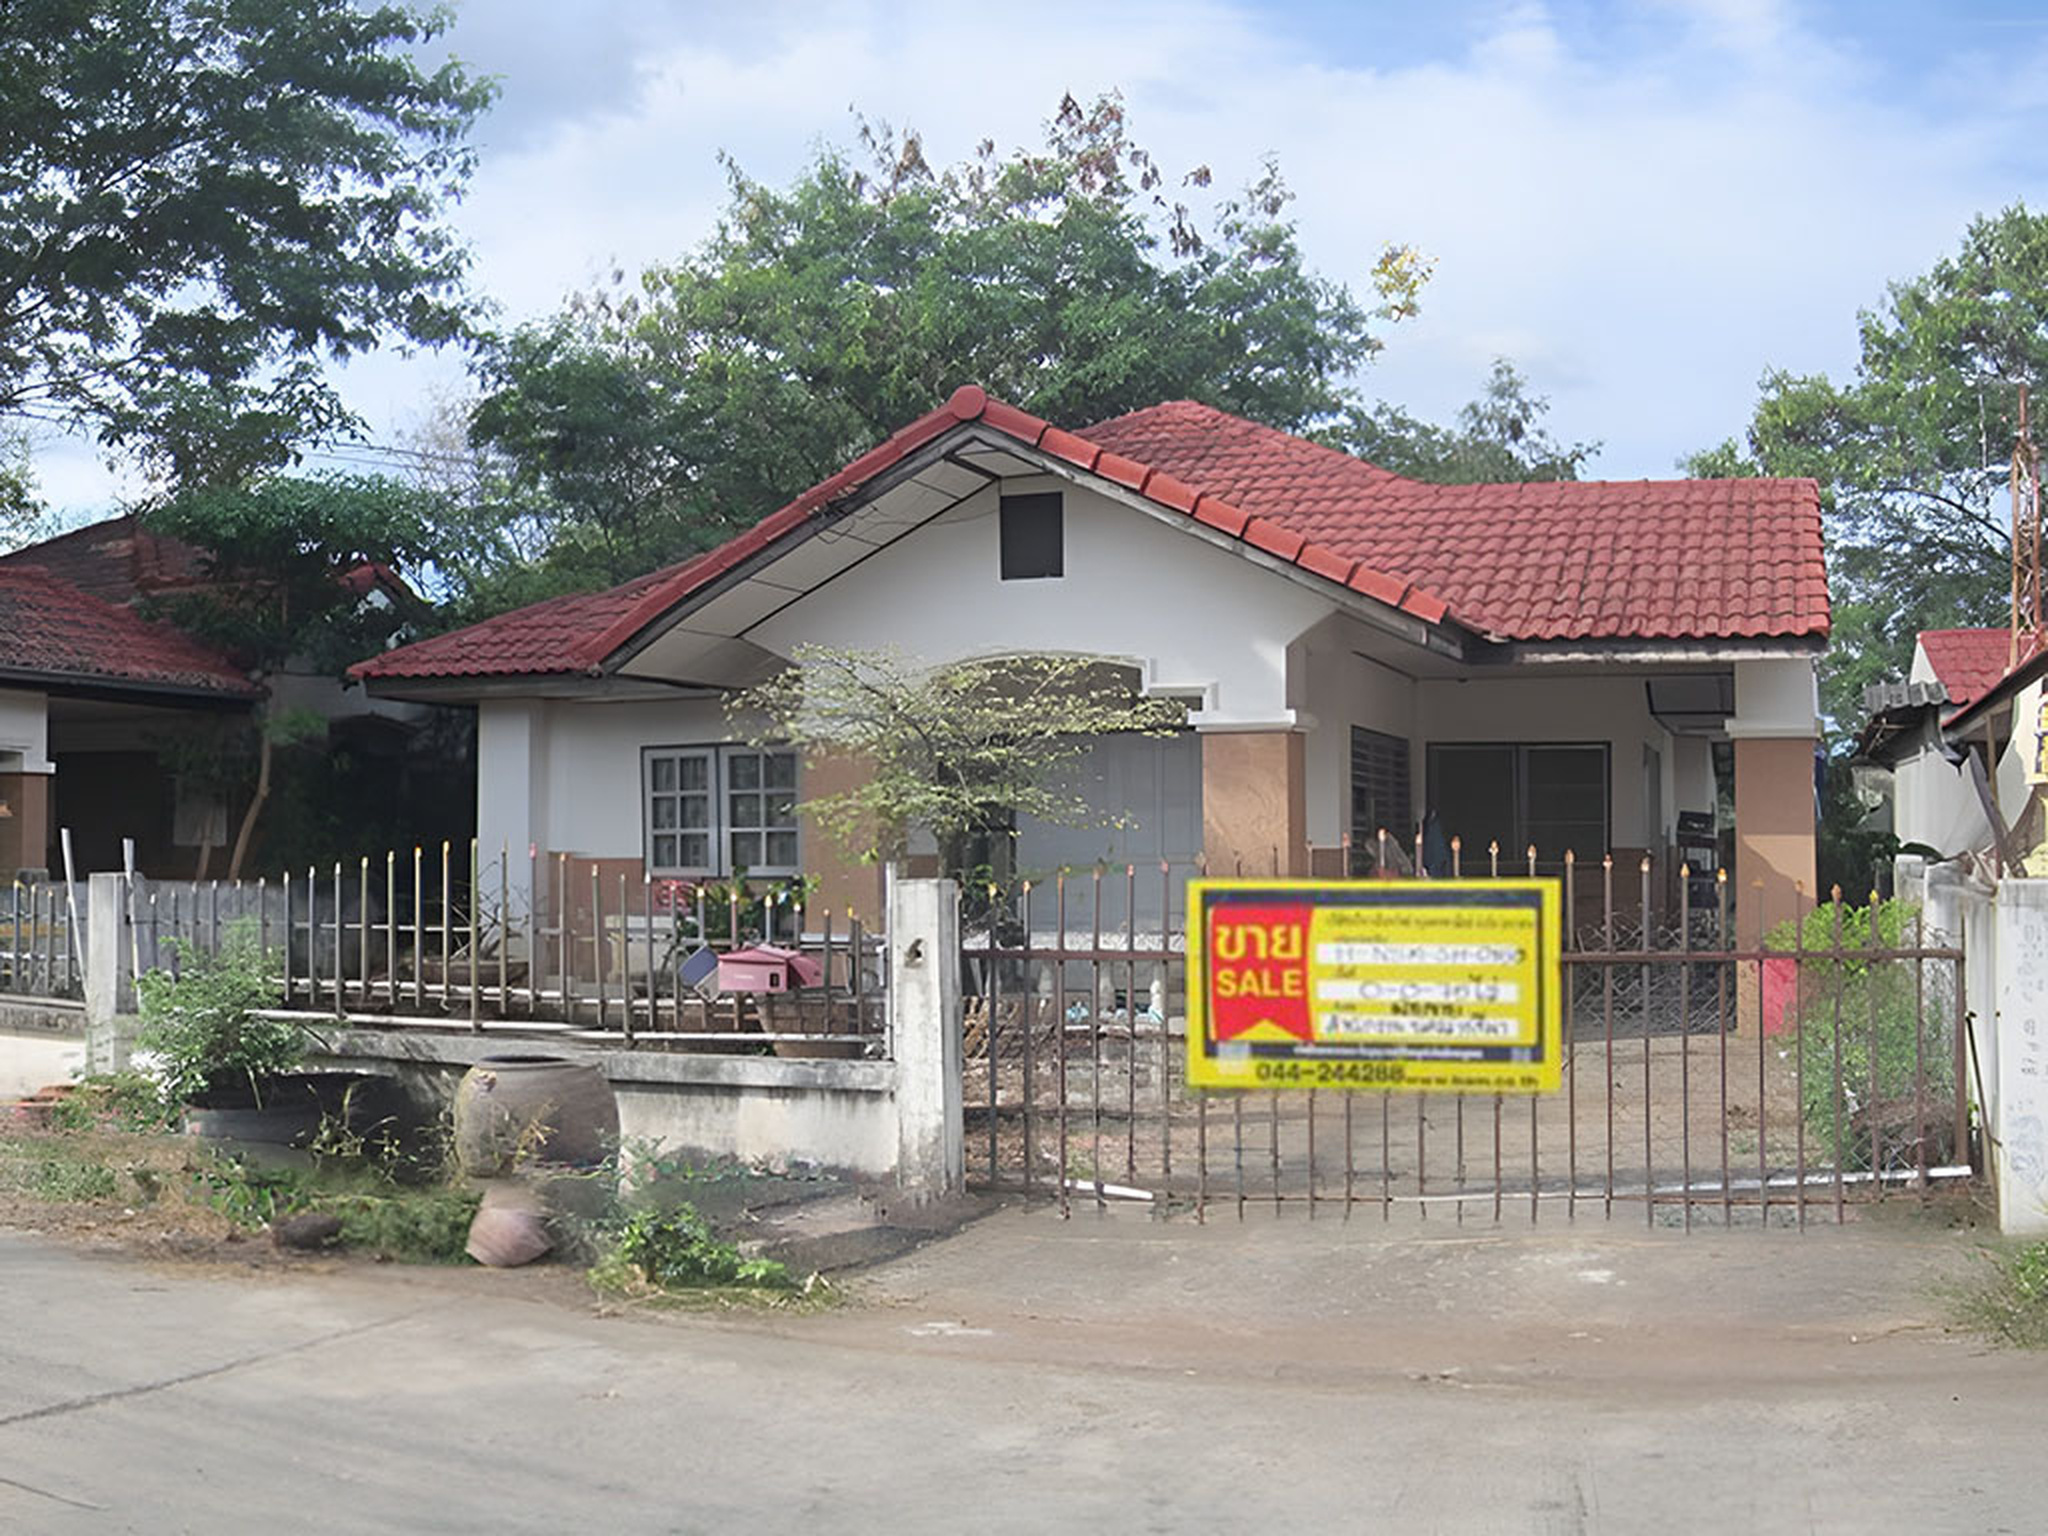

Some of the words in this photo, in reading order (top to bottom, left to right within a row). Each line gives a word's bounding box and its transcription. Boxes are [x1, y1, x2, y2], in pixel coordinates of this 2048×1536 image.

[1216, 924, 1302, 960] ขาย
[1216, 968, 1303, 998] SALE
[1256, 1062, 1404, 1084] 044-244288
